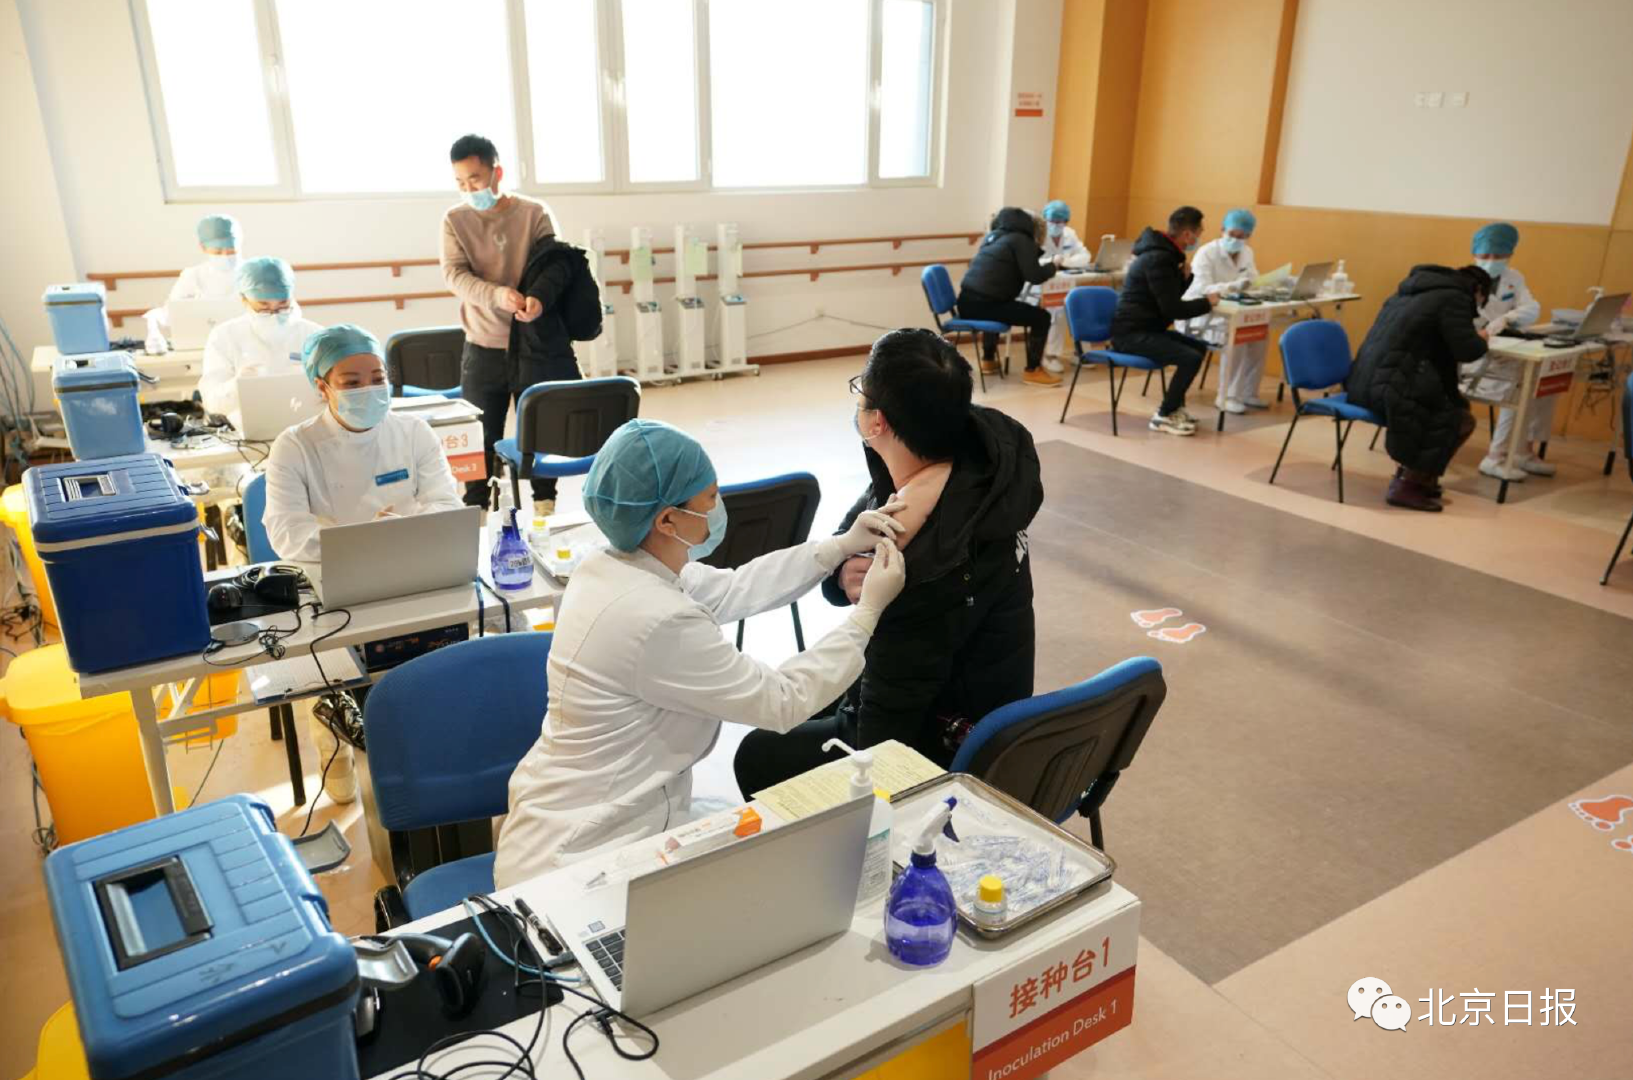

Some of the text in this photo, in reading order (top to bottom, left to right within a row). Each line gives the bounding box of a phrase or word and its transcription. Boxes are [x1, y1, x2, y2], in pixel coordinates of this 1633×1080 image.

[441, 433, 468, 449] 台3
[1009, 936, 1110, 1018] 接种台1
[988, 999, 1118, 1080] Inoculation Desk 1
